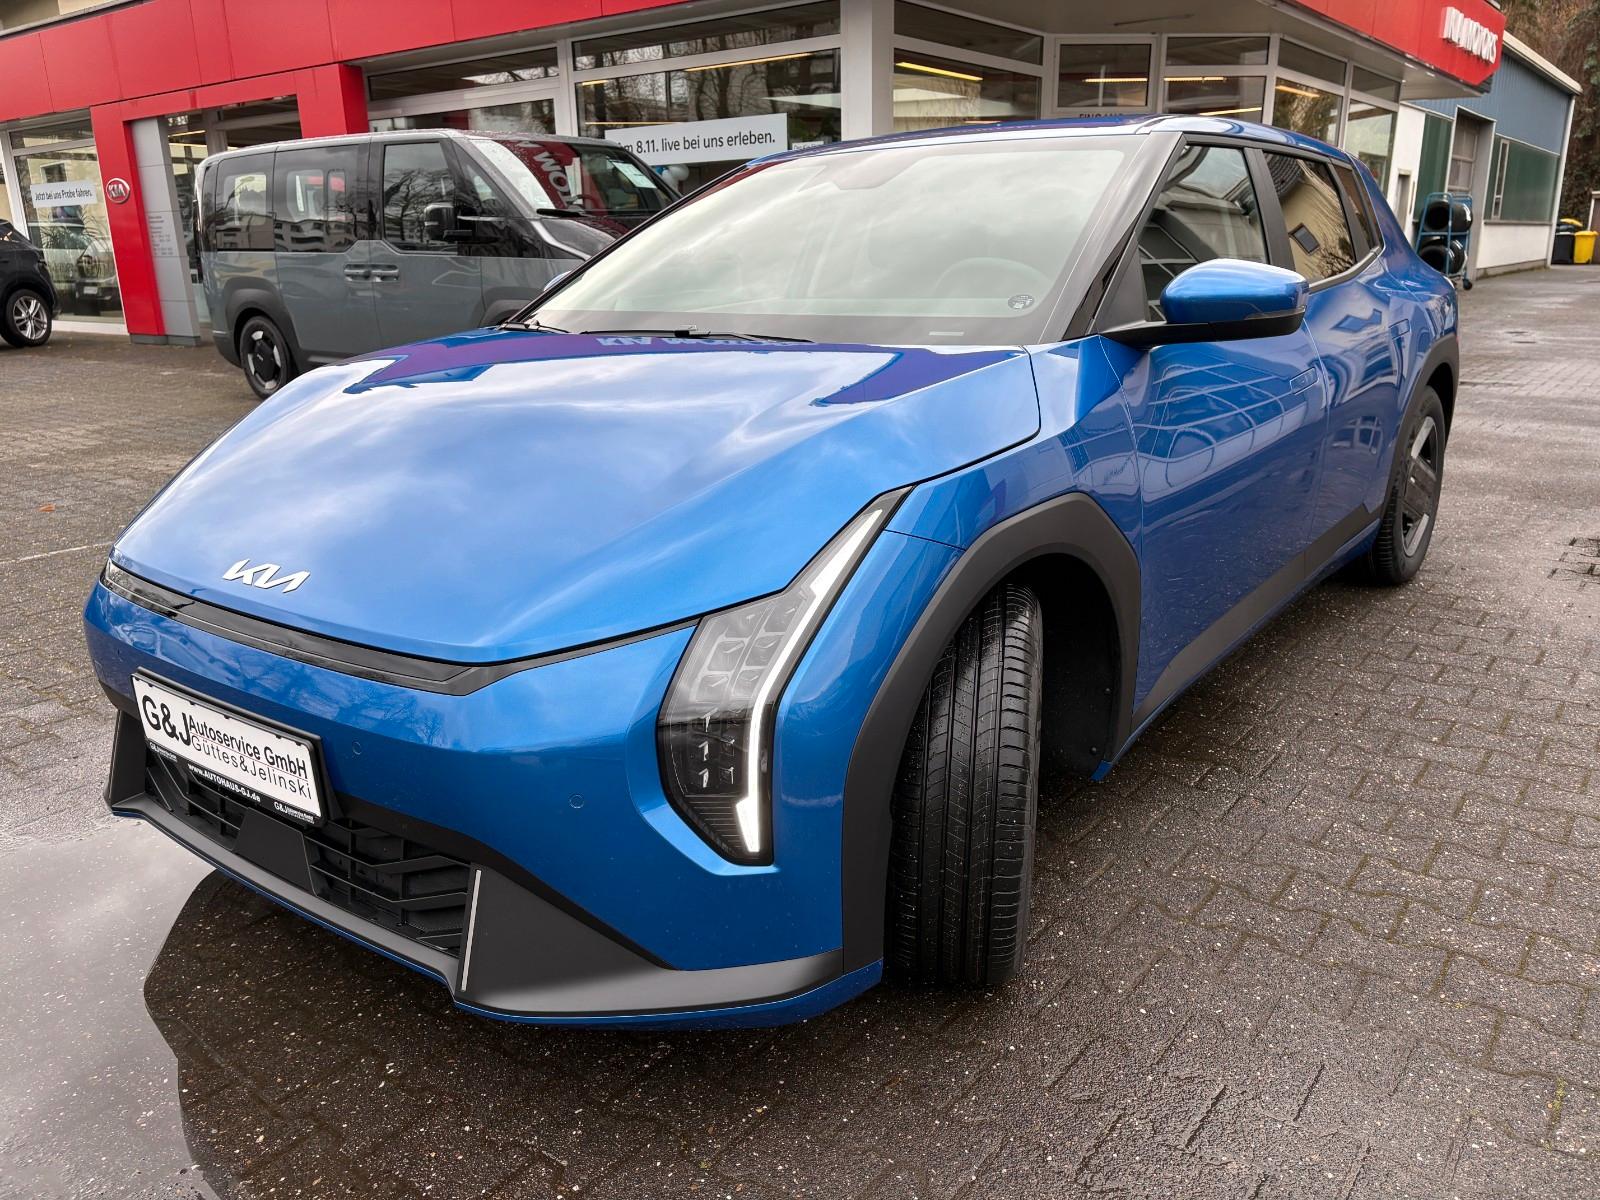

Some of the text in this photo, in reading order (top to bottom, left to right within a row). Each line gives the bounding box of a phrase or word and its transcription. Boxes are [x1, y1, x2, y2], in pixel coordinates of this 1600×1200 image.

[636, 139, 659, 154] 8.11.
[662, 137, 680, 151] live
[683, 135, 700, 149] bei
[703, 135, 724, 148] uns
[727, 130, 776, 146] erleben.
[108, 184, 126, 197] KIA
[142, 695, 191, 746] G&J
[189, 715, 308, 780] Autoservice GmbH
